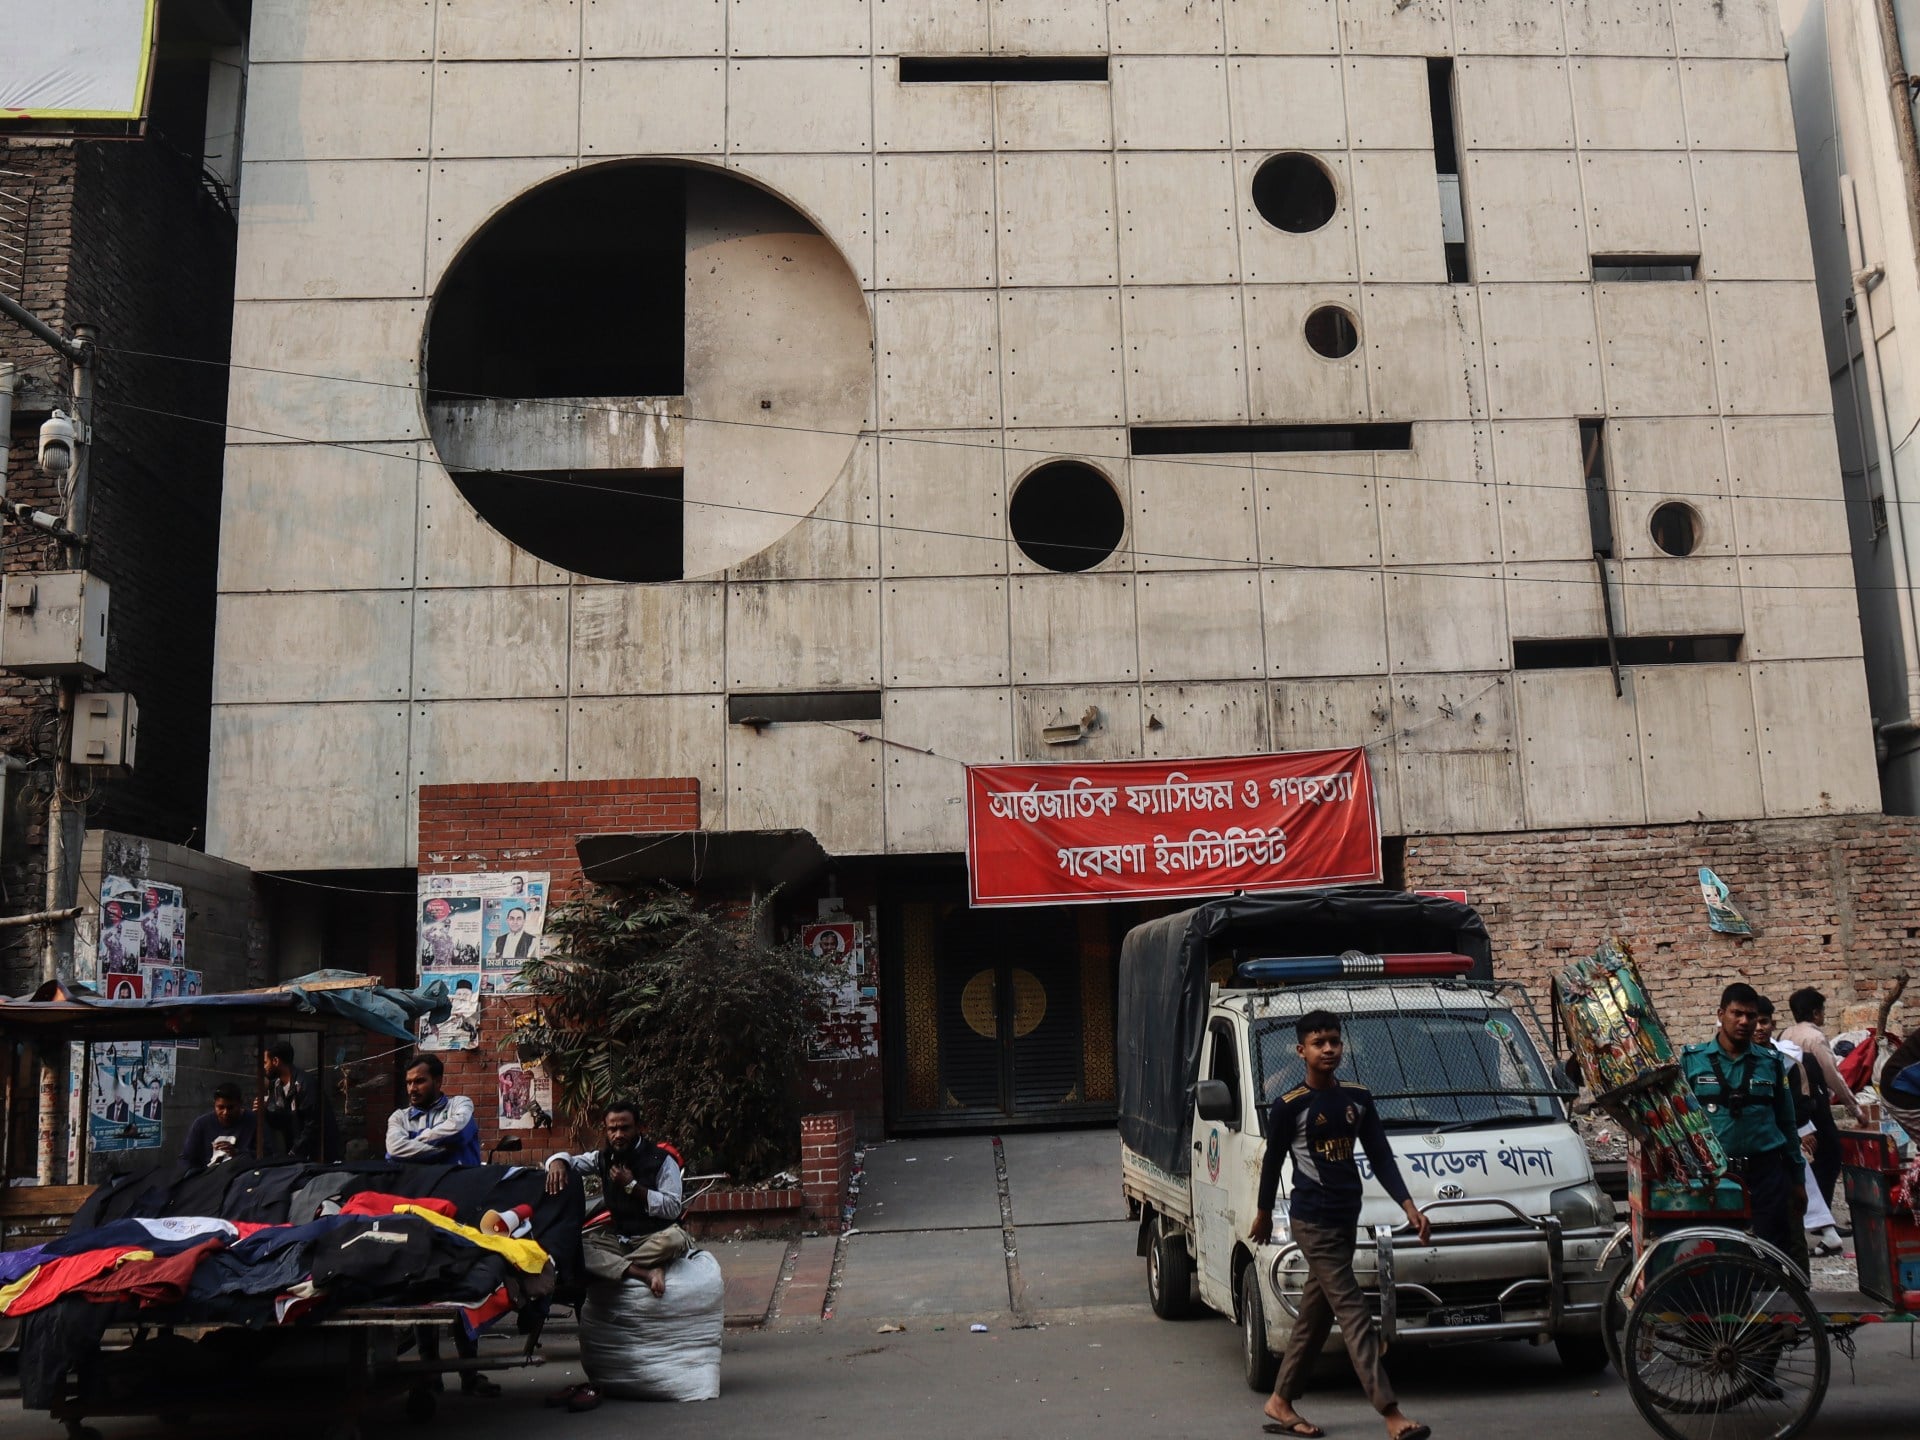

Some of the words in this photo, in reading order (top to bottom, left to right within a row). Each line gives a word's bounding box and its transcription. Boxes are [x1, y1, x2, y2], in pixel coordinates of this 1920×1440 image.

[1124, 771, 1234, 815] ফ্যাসিজম
[1240, 780, 1260, 809] ও
[1269, 770, 1352, 807] গণহত্যা
[1056, 844, 1146, 878] গবেষণা
[1154, 826, 1287, 876] ইনস্টিটিউট
[1404, 1149, 1488, 1178] মডেল
[1496, 1139, 1554, 1177] থানা
